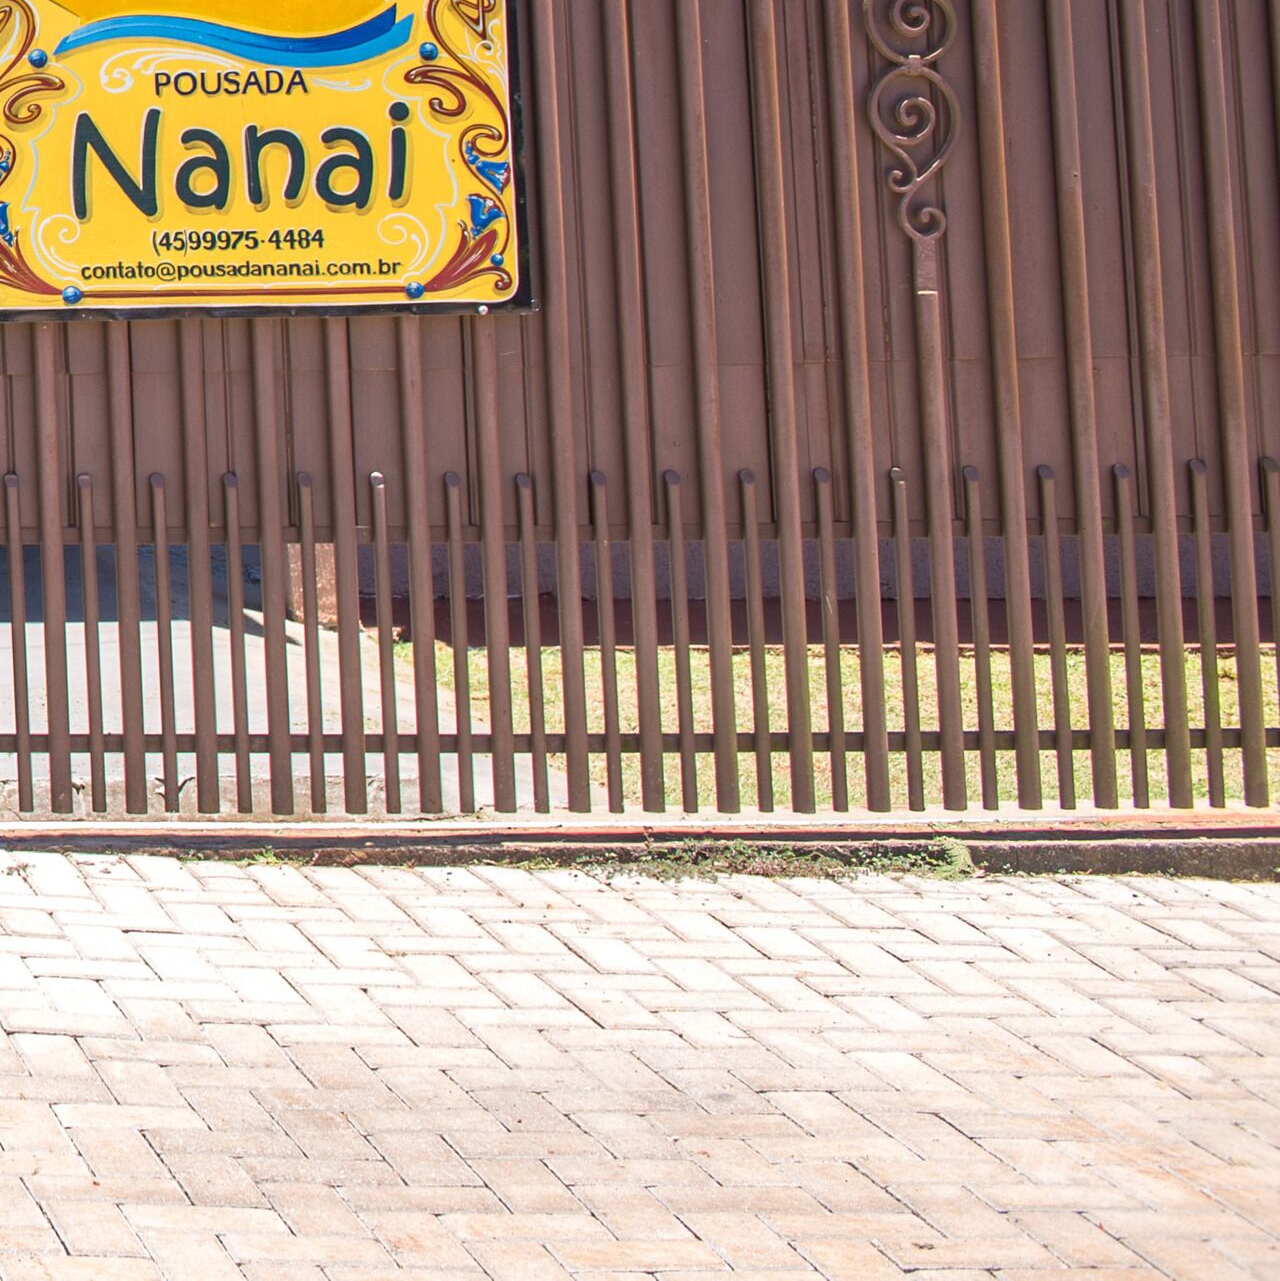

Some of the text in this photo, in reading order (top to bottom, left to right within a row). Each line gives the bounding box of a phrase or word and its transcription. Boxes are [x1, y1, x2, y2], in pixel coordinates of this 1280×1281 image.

[154, 70, 309, 97] POUSADA
[71, 101, 412, 220] Nanai
[81, 258, 402, 282] contato@pousadananai.com.br
